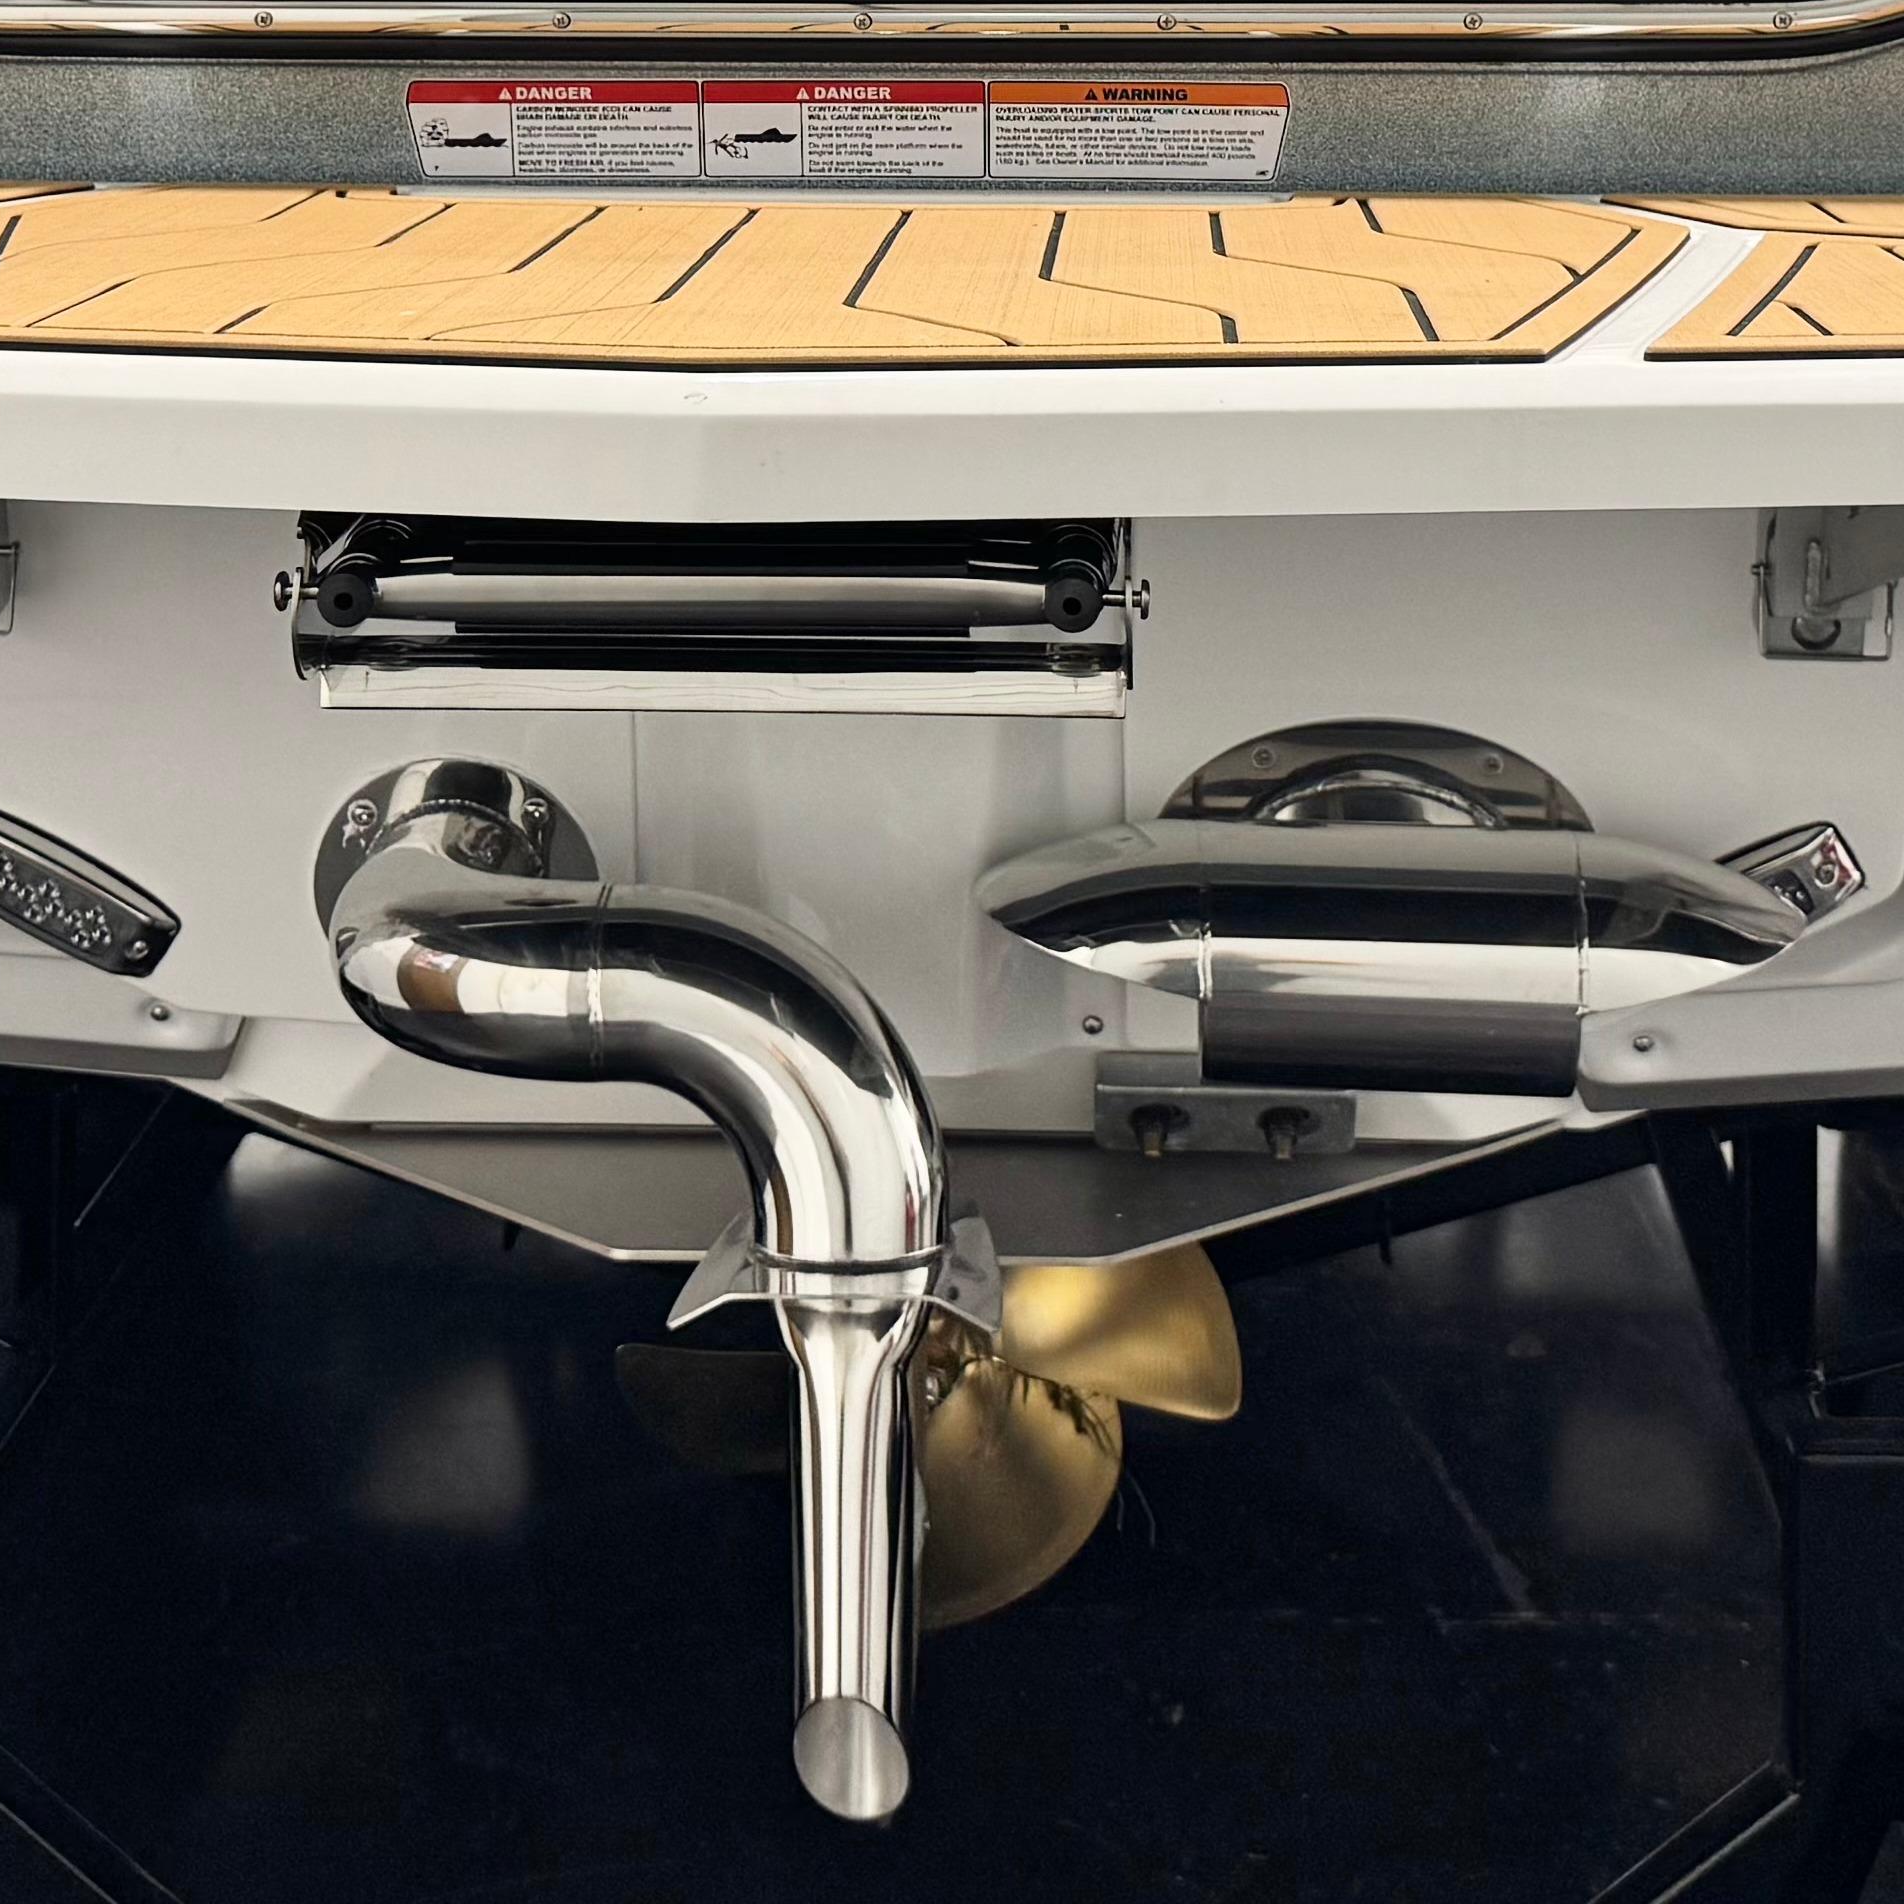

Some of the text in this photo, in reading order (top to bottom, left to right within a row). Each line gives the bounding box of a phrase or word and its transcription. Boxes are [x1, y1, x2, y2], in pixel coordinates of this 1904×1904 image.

[516, 87, 592, 100] DANGER
[814, 87, 891, 100] DANGER
[1103, 88, 1188, 101] WARNING
